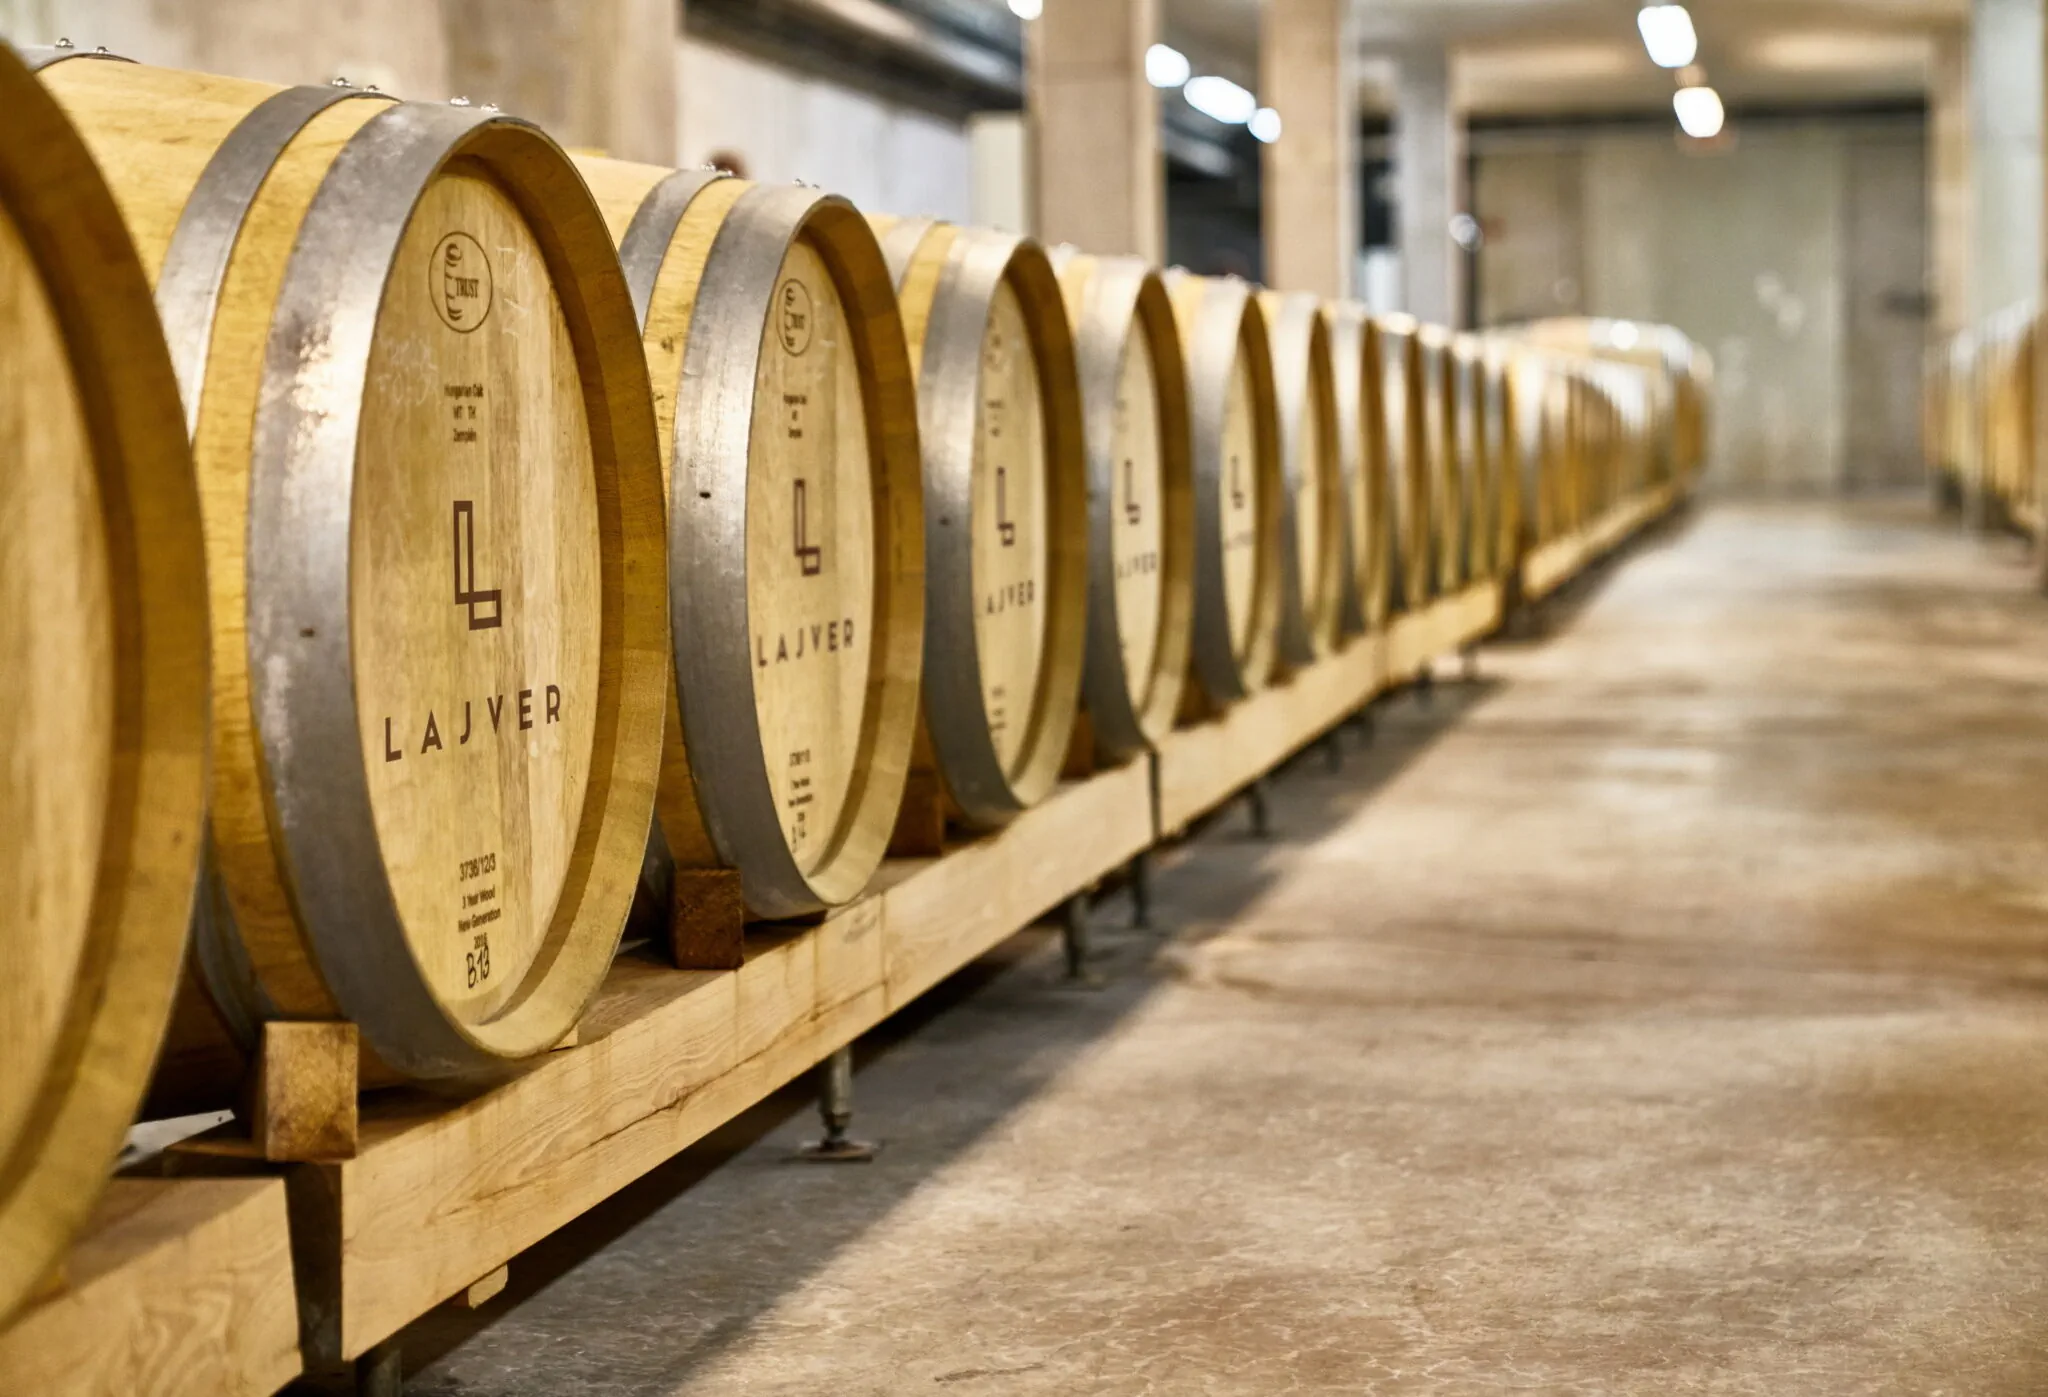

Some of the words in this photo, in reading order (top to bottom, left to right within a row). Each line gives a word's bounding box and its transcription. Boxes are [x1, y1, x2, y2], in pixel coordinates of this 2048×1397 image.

[455, 277, 479, 298] TRUST
[757, 618, 854, 667] LAJVER
[385, 684, 562, 762] LAJVER
[471, 908, 501, 929] Generation
